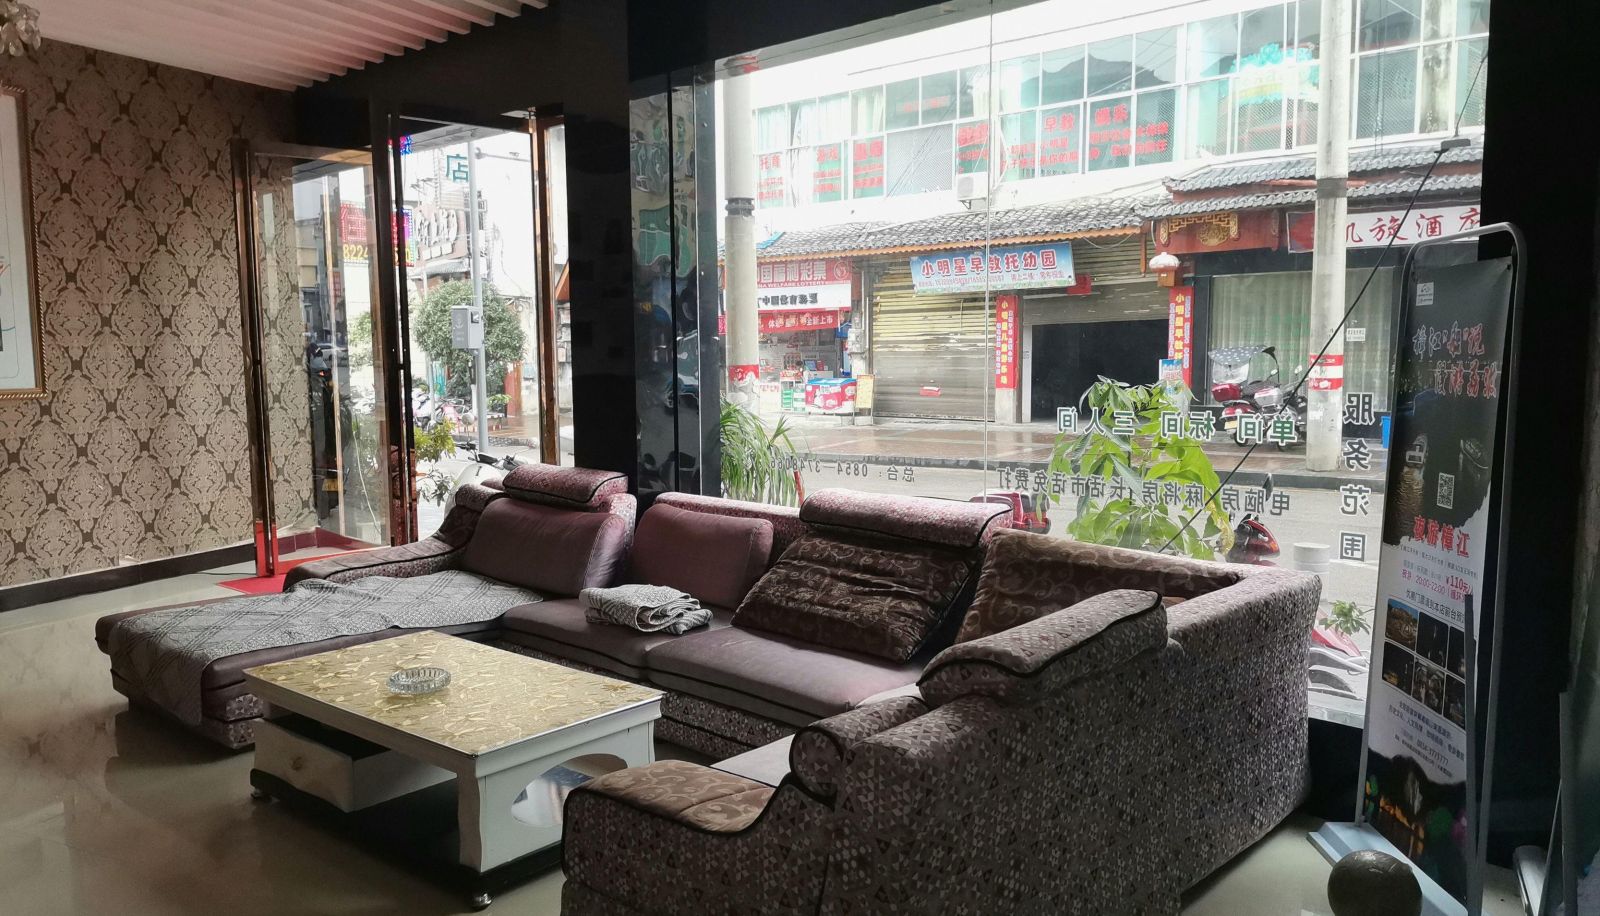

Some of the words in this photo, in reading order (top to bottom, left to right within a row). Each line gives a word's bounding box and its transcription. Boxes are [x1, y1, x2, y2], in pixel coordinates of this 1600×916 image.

[757, 261, 827, 283] 国福利彩票
[921, 250, 1057, 278] 小明星早教托幼园
